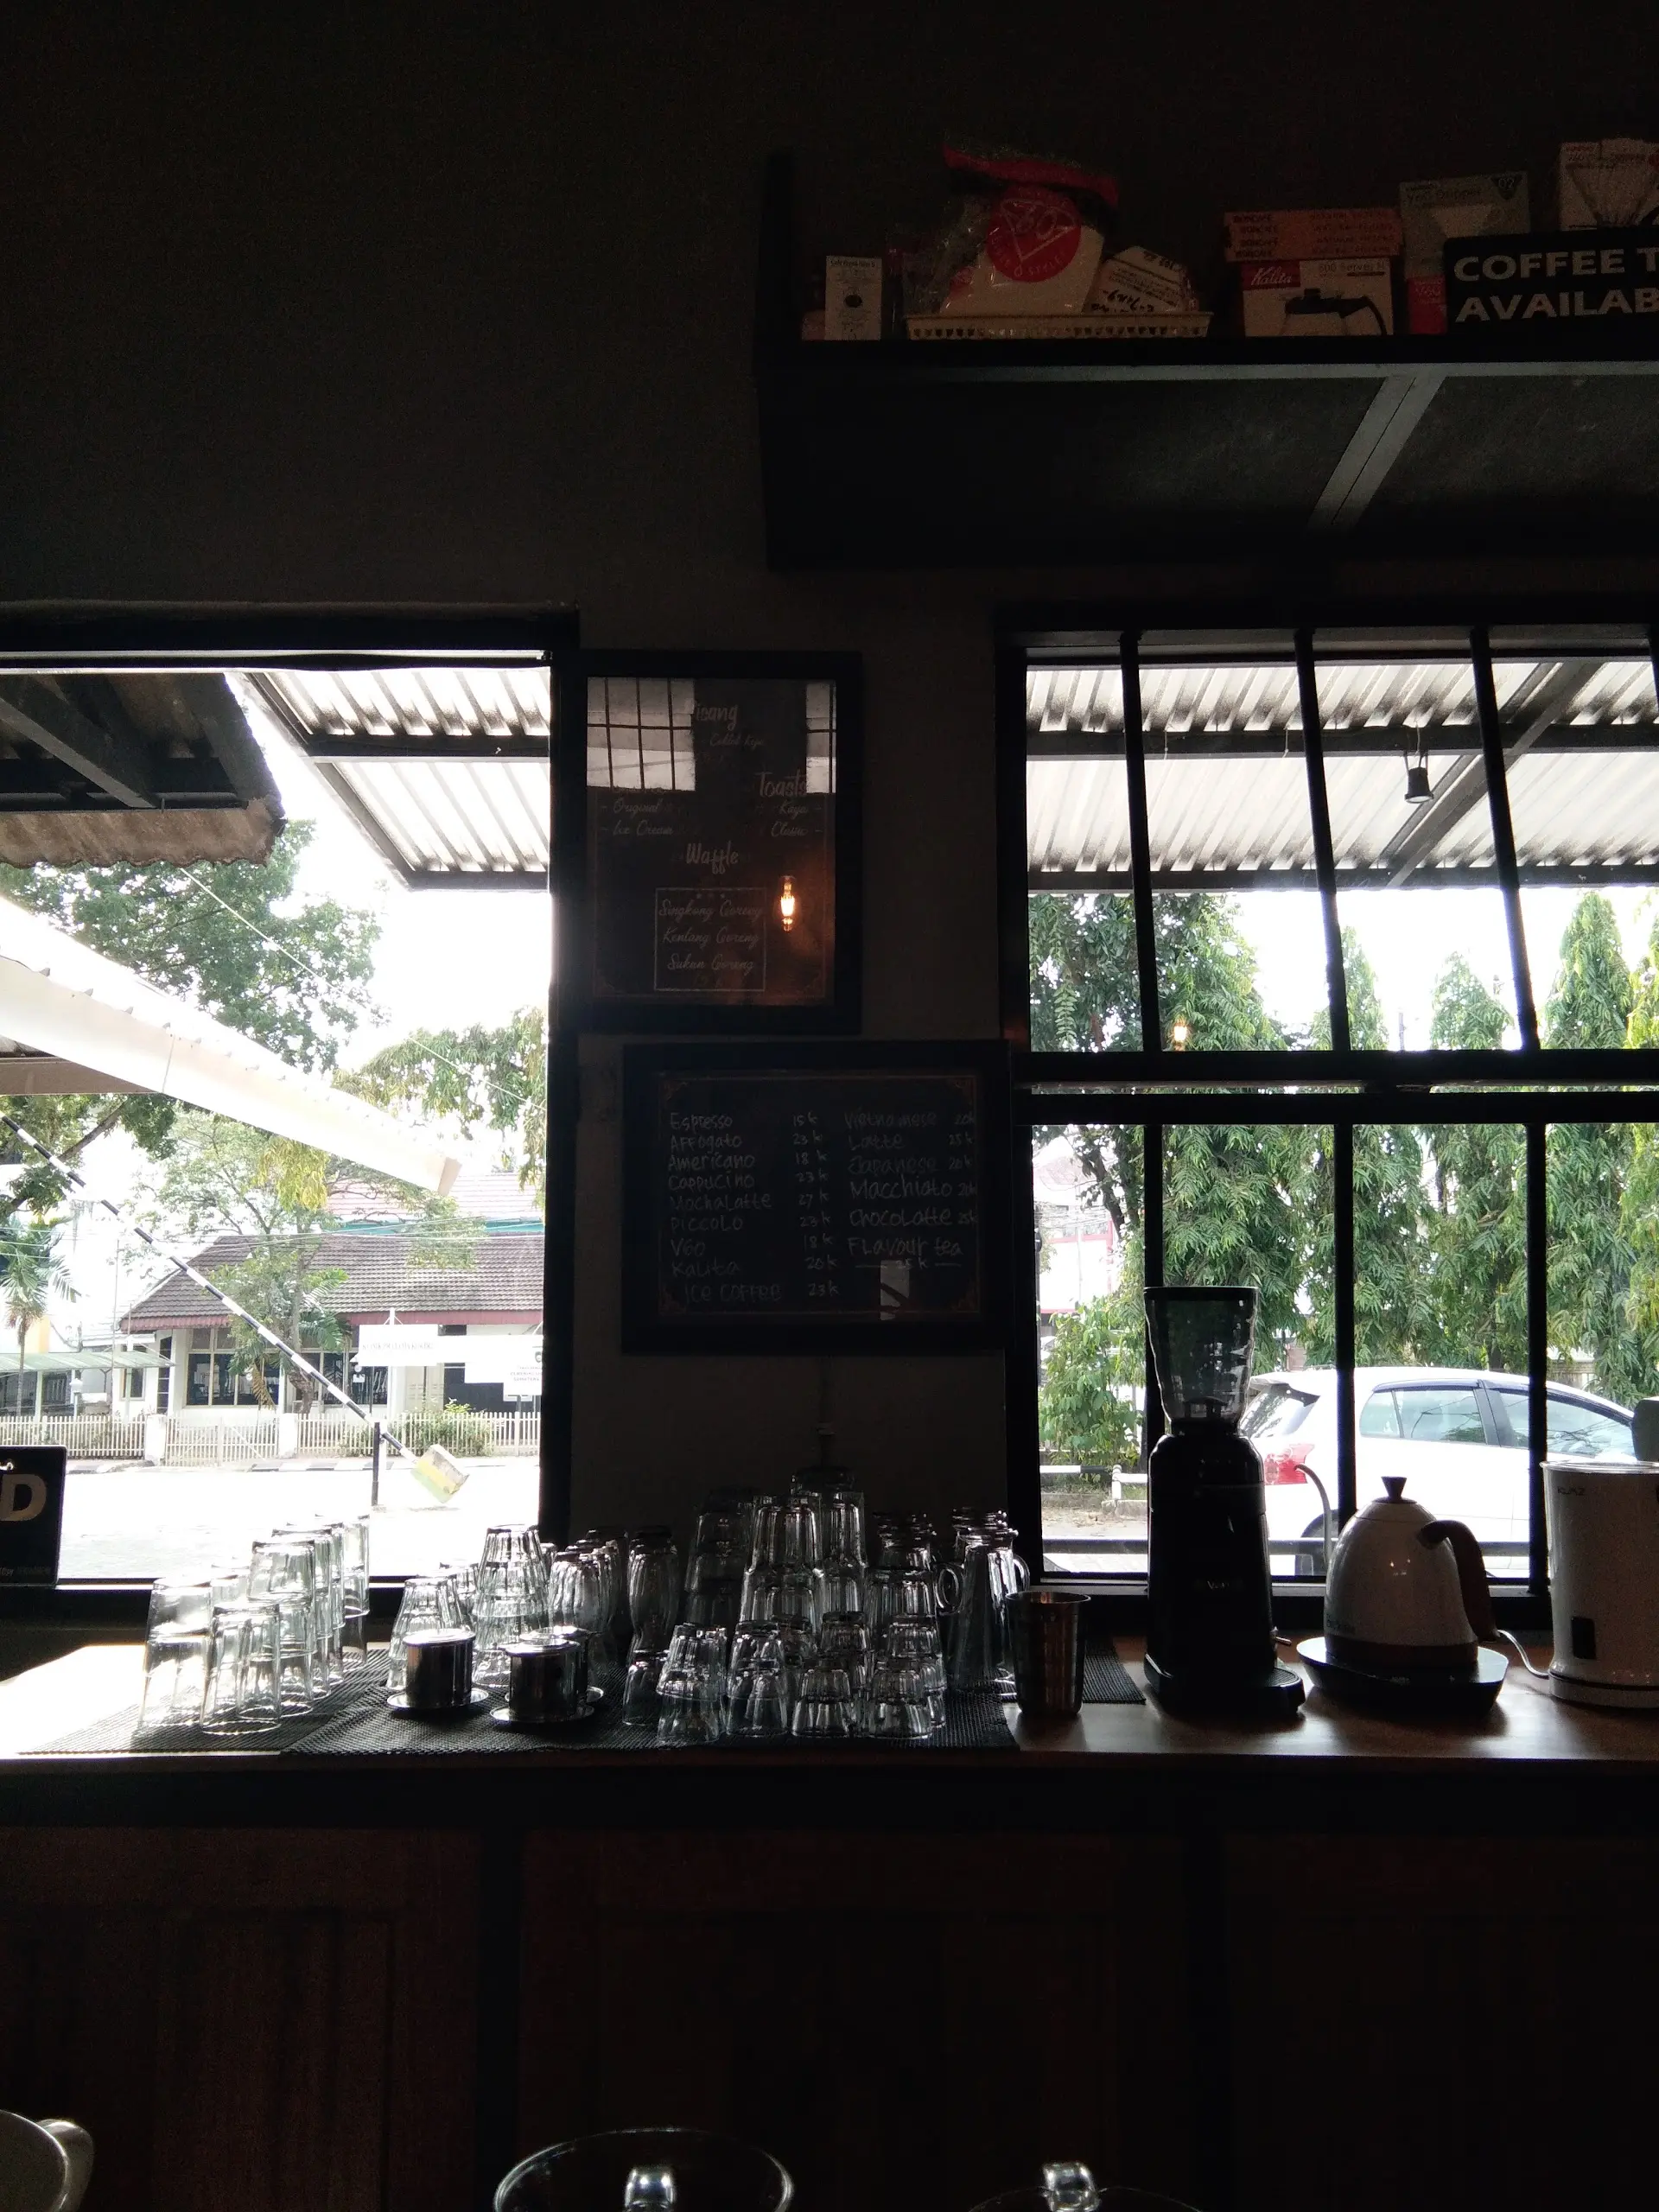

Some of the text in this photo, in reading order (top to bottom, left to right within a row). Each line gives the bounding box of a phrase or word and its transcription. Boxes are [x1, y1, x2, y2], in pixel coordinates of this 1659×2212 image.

[1250, 265, 1294, 286] Kalita
[1453, 248, 1626, 283] COFFEE
[1454, 286, 1659, 324] AVAILAB
[685, 840, 740, 874] Waffle
[670, 1112, 733, 1135] Espresso
[848, 1134, 906, 1151] Latte
[668, 1151, 756, 1172] Americano
[848, 1154, 938, 1177] Japanese
[850, 1173, 953, 1199] Macchiato
